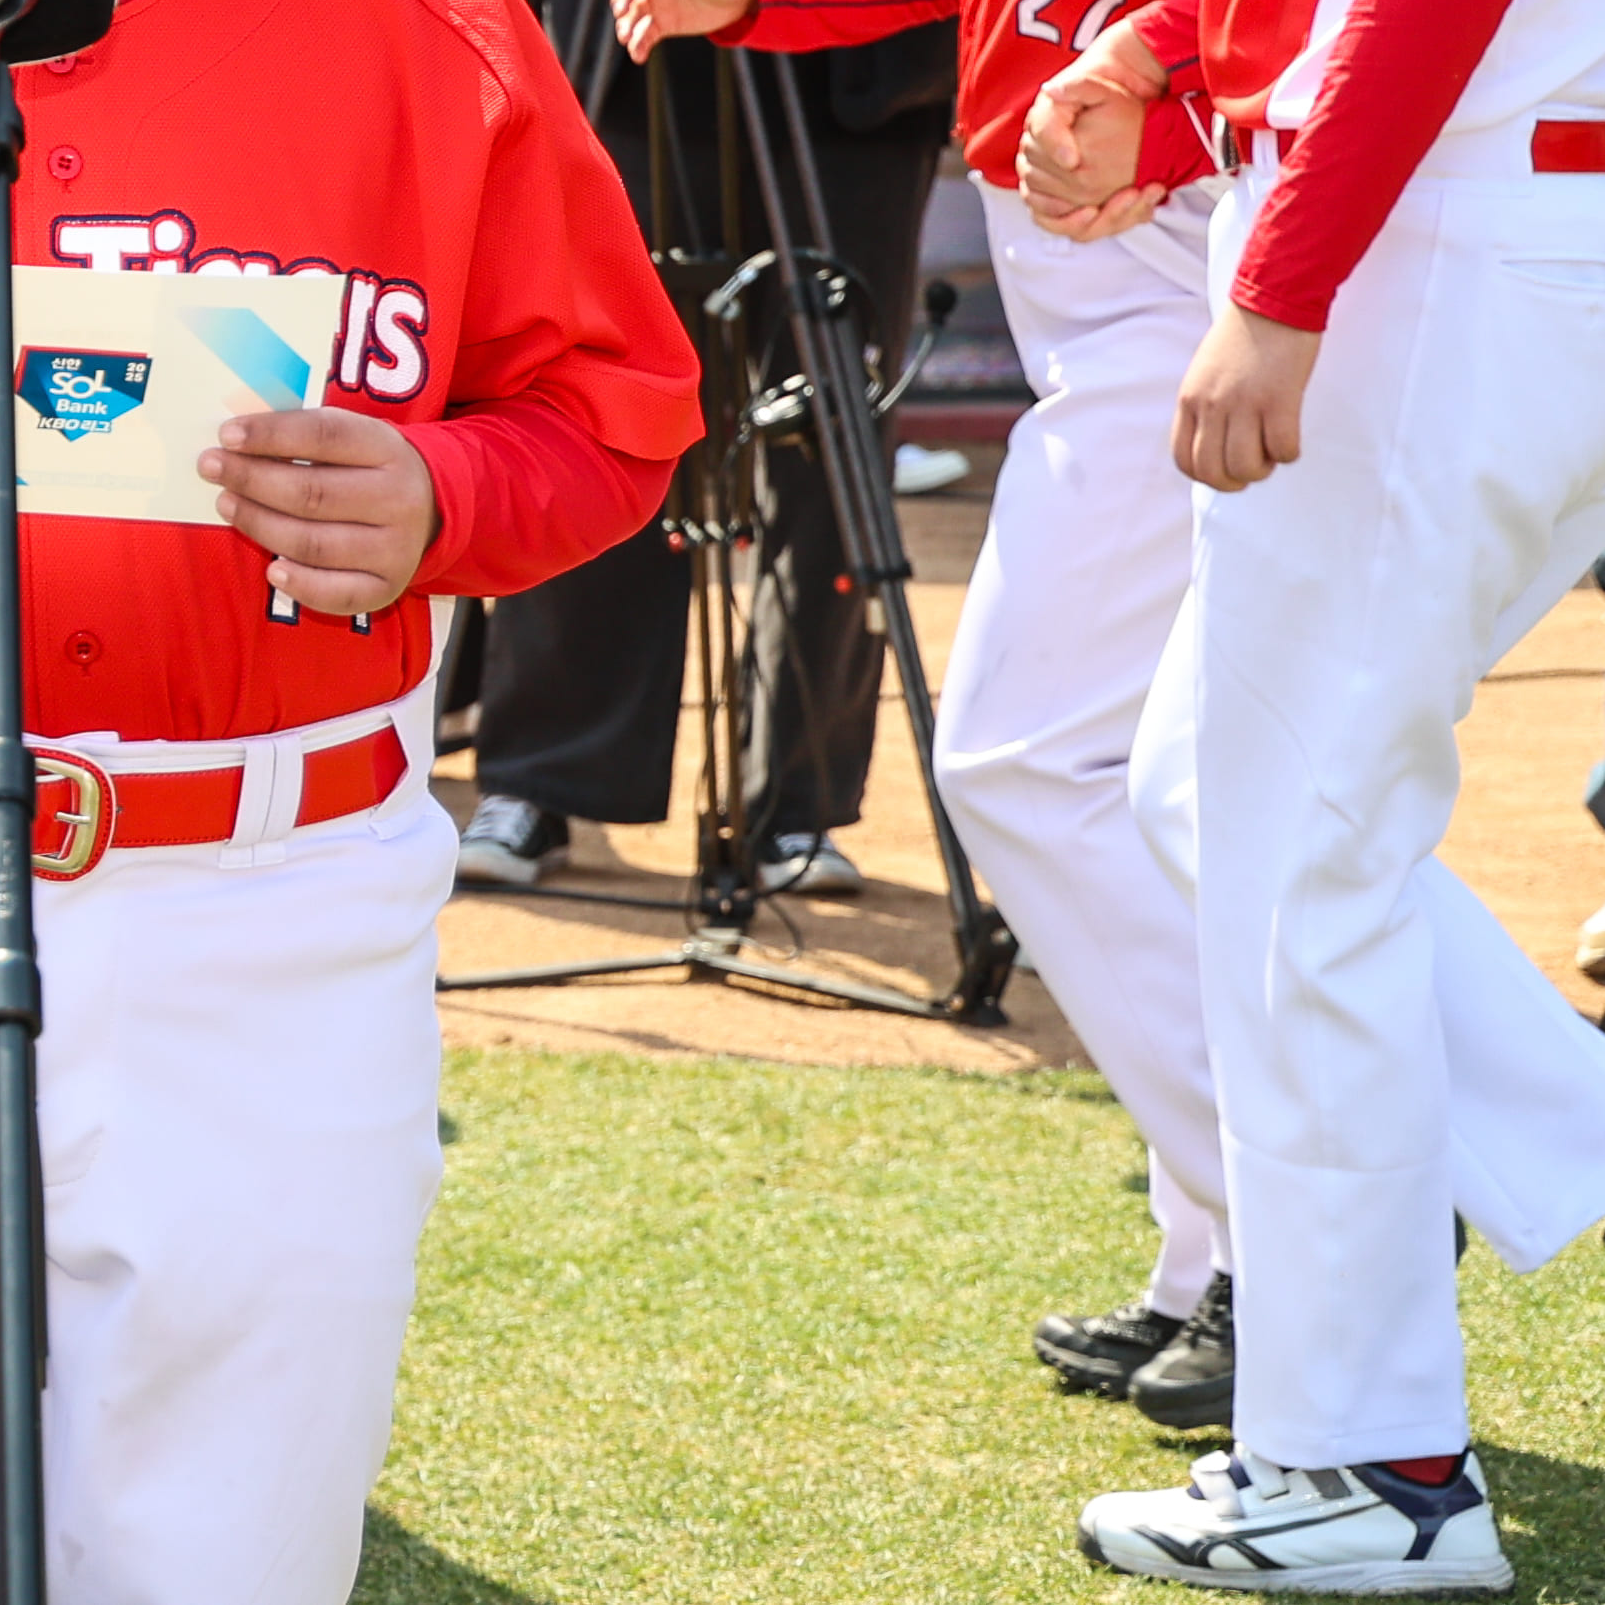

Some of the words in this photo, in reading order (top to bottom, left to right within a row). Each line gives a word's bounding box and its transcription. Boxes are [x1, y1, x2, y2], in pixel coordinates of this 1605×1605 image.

[126, 362, 147, 373] 20
[124, 372, 145, 383] 25
[55, 398, 109, 415] Bank
[39, 416, 80, 431] KBO
